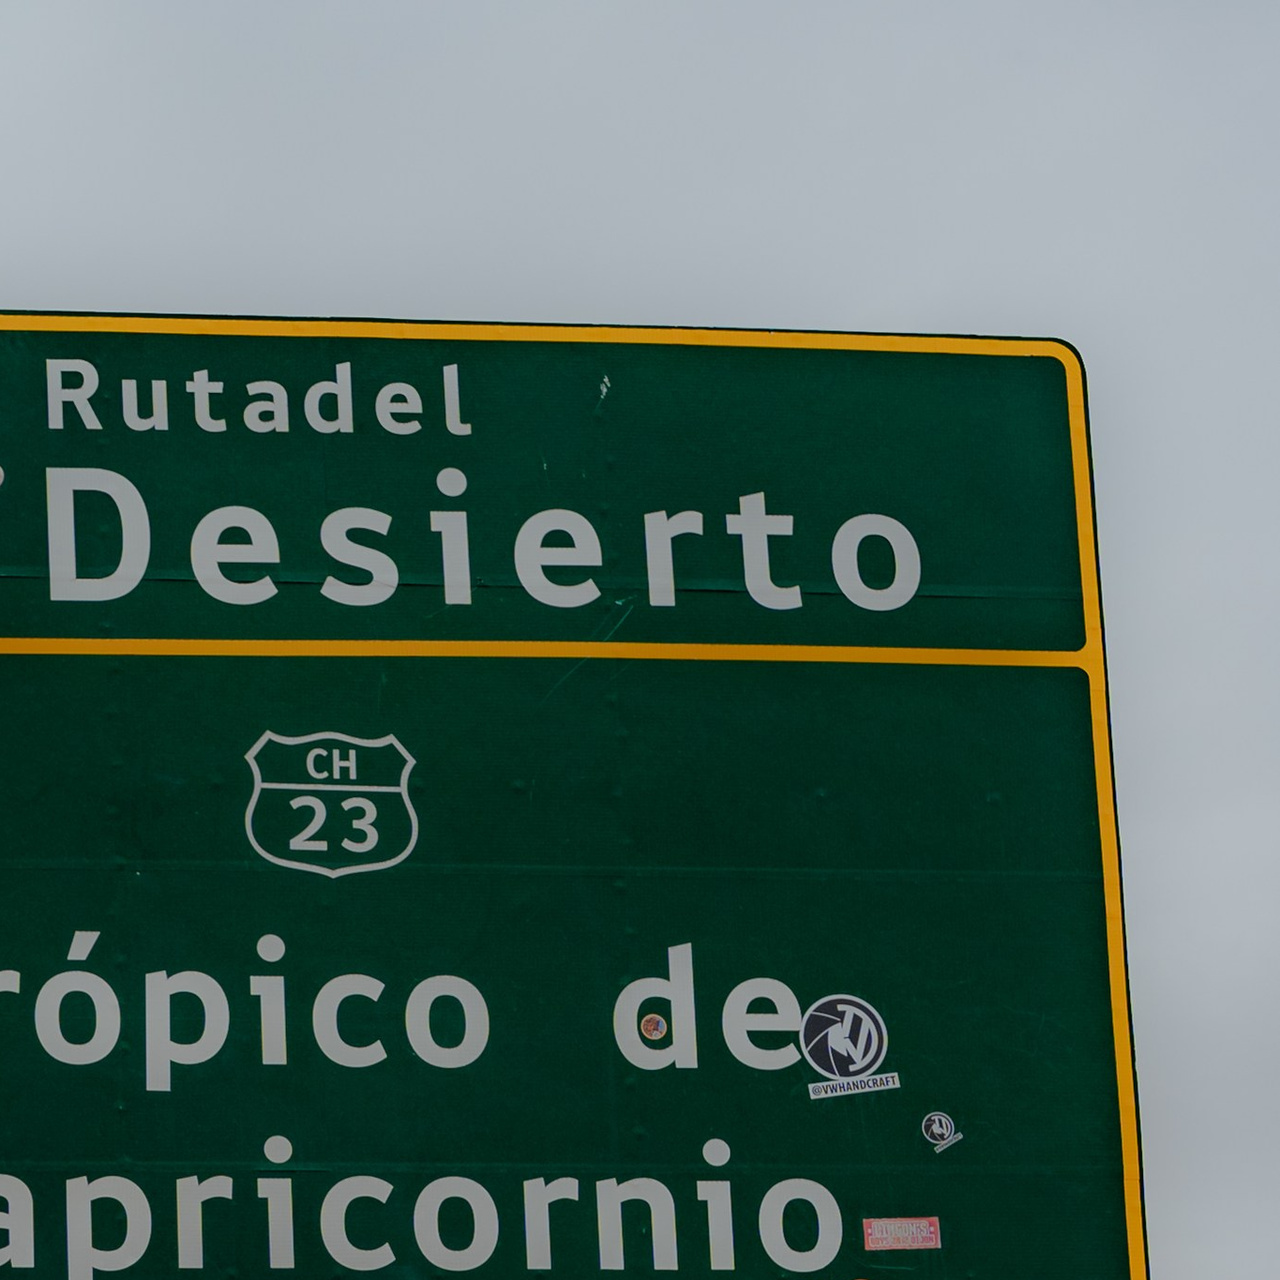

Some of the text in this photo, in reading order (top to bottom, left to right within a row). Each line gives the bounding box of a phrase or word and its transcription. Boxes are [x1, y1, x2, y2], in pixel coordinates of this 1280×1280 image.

[44, 466, 922, 613] Desierto
[304, 747, 357, 782] CH
[288, 795, 380, 853] 23
[612, 942, 805, 1070] de
[811, 1075, 897, 1097] @VWHANDCRAFT
